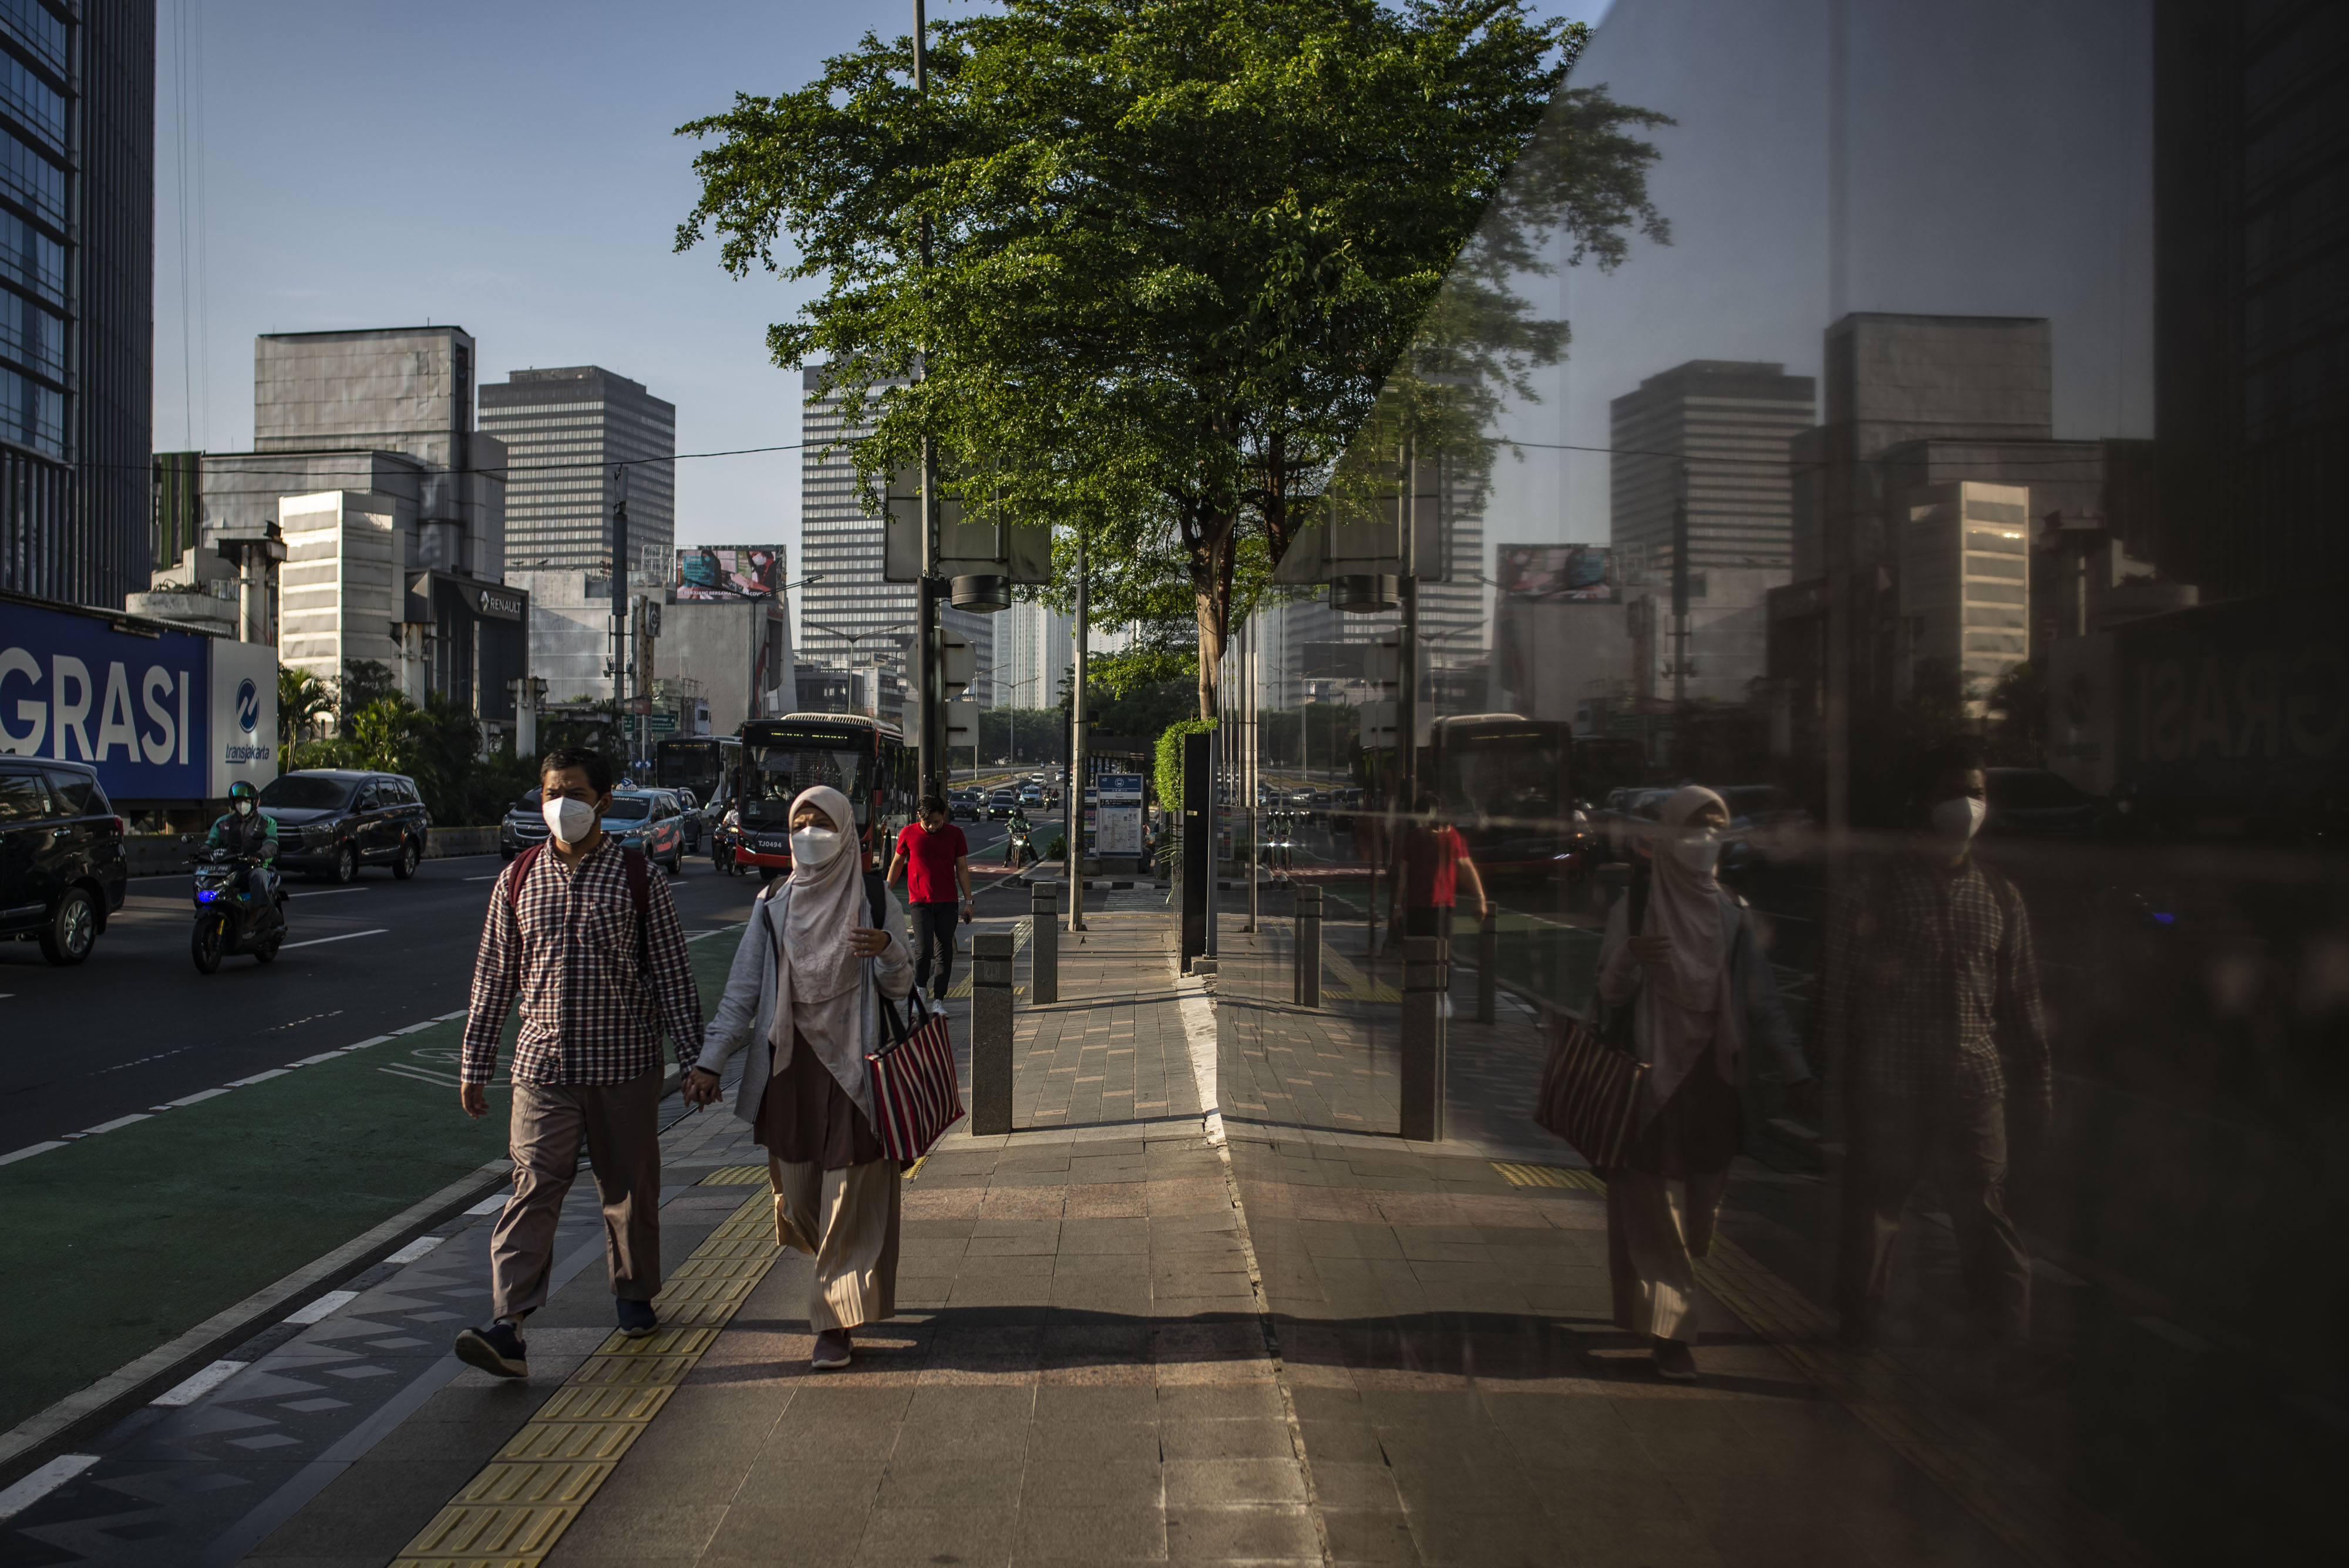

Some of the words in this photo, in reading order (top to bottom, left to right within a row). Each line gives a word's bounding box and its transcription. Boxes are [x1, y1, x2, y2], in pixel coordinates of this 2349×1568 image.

[490, 597, 521, 614] RENAULT
[0, 647, 189, 765] GRASI
[225, 742, 270, 763] transjakarta
